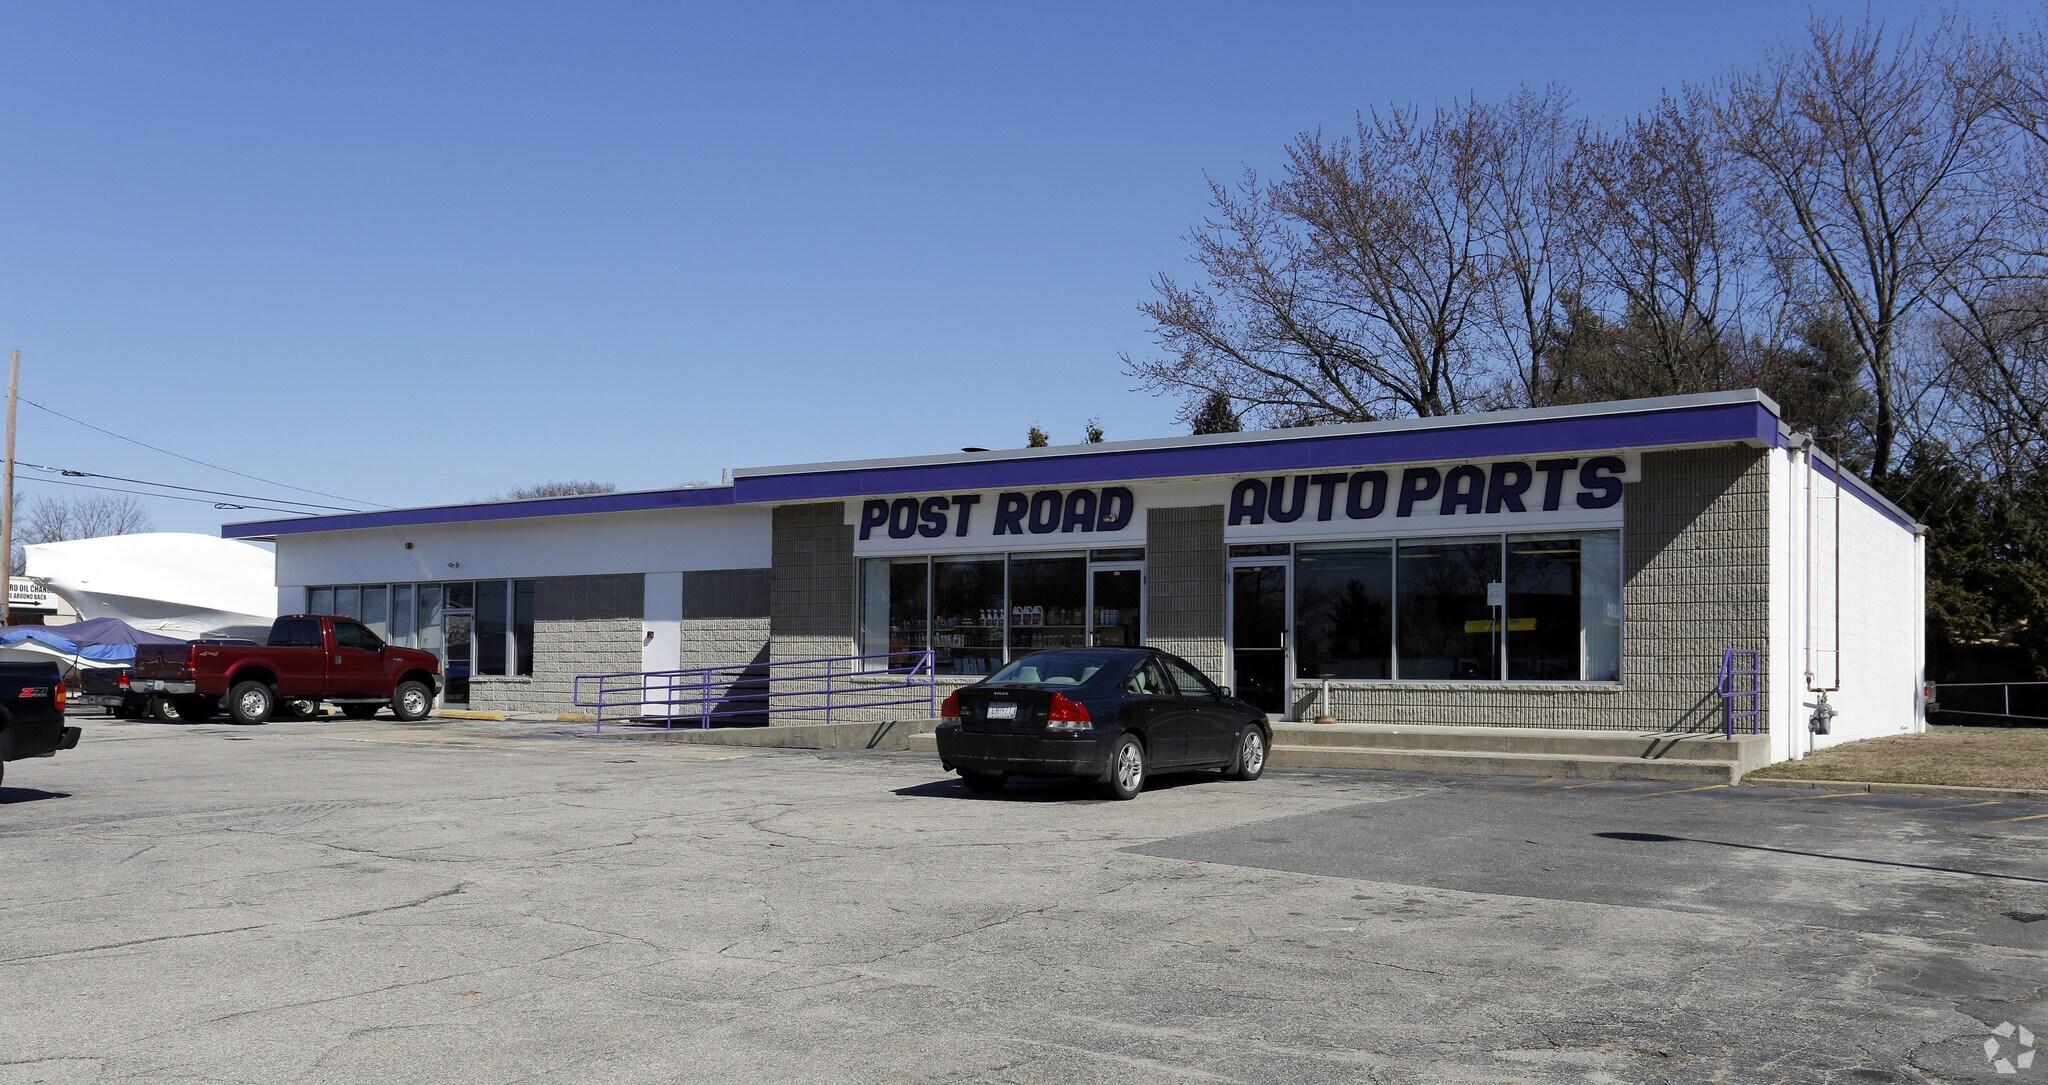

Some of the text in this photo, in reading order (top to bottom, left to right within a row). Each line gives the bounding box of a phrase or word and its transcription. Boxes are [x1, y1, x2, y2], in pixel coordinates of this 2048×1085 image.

[859, 456, 1626, 540] POST ROAD AUTO PARTS
[9, 584, 53, 594] RU OIL CHAN
[13, 592, 33, 600] AROUND
[34, 593, 47, 601] BACK
